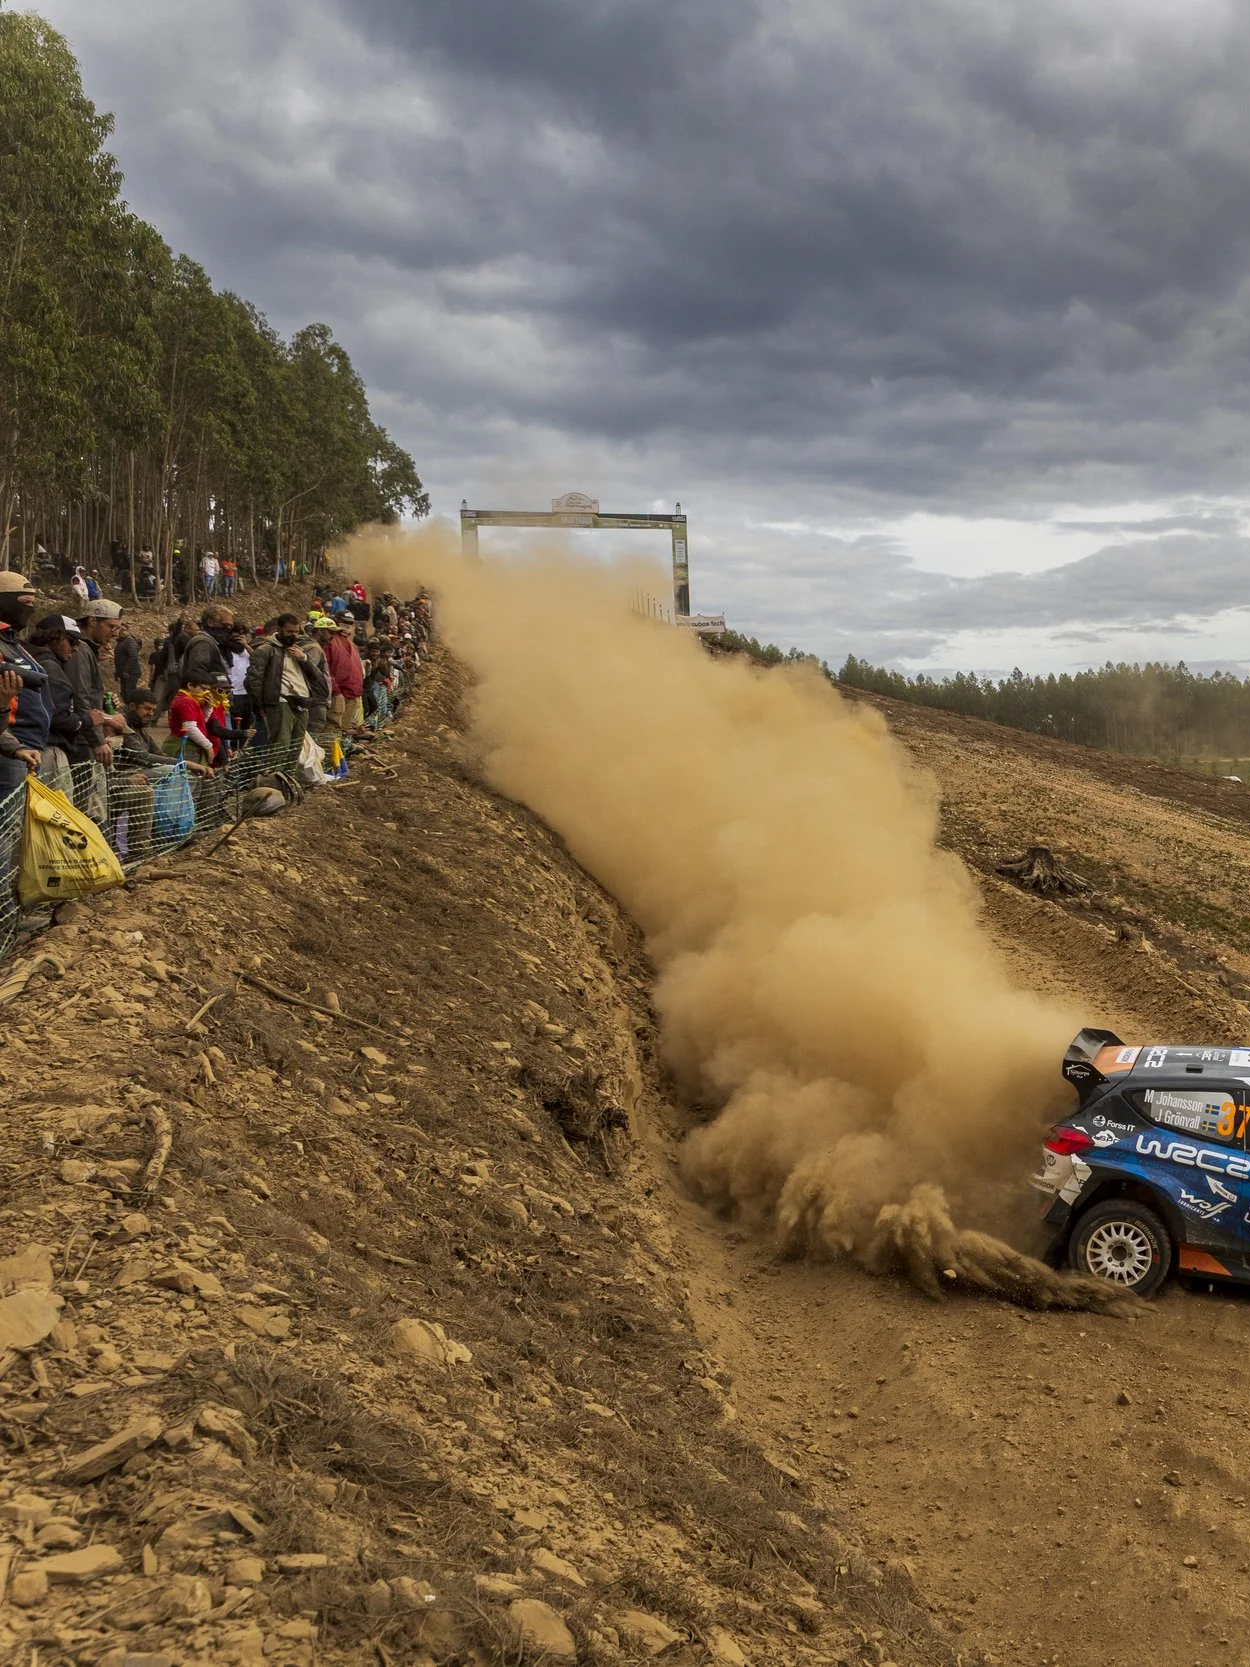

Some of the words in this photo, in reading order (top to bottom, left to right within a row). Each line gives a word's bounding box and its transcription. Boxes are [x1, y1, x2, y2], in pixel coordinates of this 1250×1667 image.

[1144, 1089, 1155, 1103] M
[1156, 1092, 1203, 1113] Johansson
[1106, 1119, 1127, 1131] Forss
[1126, 1123, 1136, 1133] IT
[1155, 1108, 1162, 1122] J
[1164, 1111, 1201, 1130] Grönvall
[1178, 1198, 1206, 1216] LUBRICANTS
